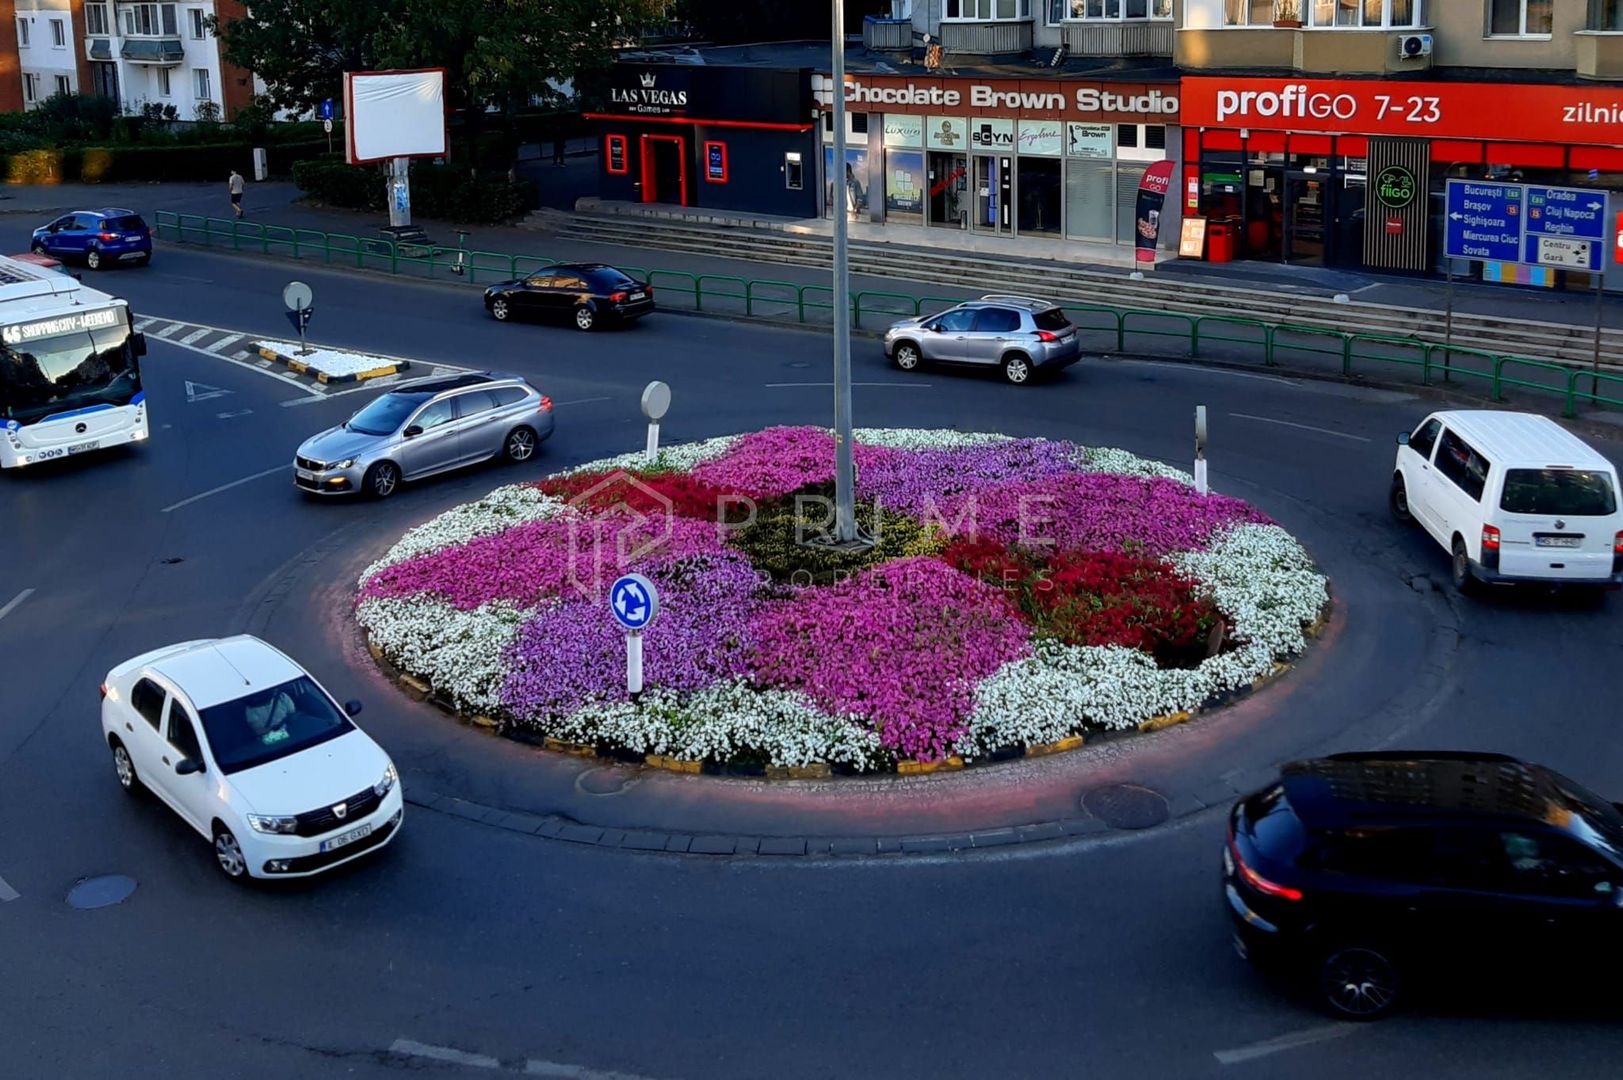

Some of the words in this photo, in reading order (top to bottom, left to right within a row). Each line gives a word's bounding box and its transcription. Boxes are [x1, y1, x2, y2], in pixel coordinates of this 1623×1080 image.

[611, 88, 638, 103] LAS
[640, 89, 687, 105] VEGAS
[843, 81, 960, 106] Chocolate
[970, 85, 1065, 110] Brown
[1076, 88, 1179, 114] Studio
[637, 104, 661, 113] Games
[1374, 95, 1441, 123] 7-23
[1146, 174, 1169, 184] profi
[1546, 190, 1576, 201] Oradea
[1545, 206, 1562, 218] Cluj
[1564, 208, 1595, 220] Napoca
[1544, 221, 1575, 235] Reghin
[1462, 230, 1499, 243] Miercurea
[1500, 233, 1519, 244] Ciuc
[1462, 245, 1490, 256] Sovata
[1543, 239, 1571, 250] Centru
